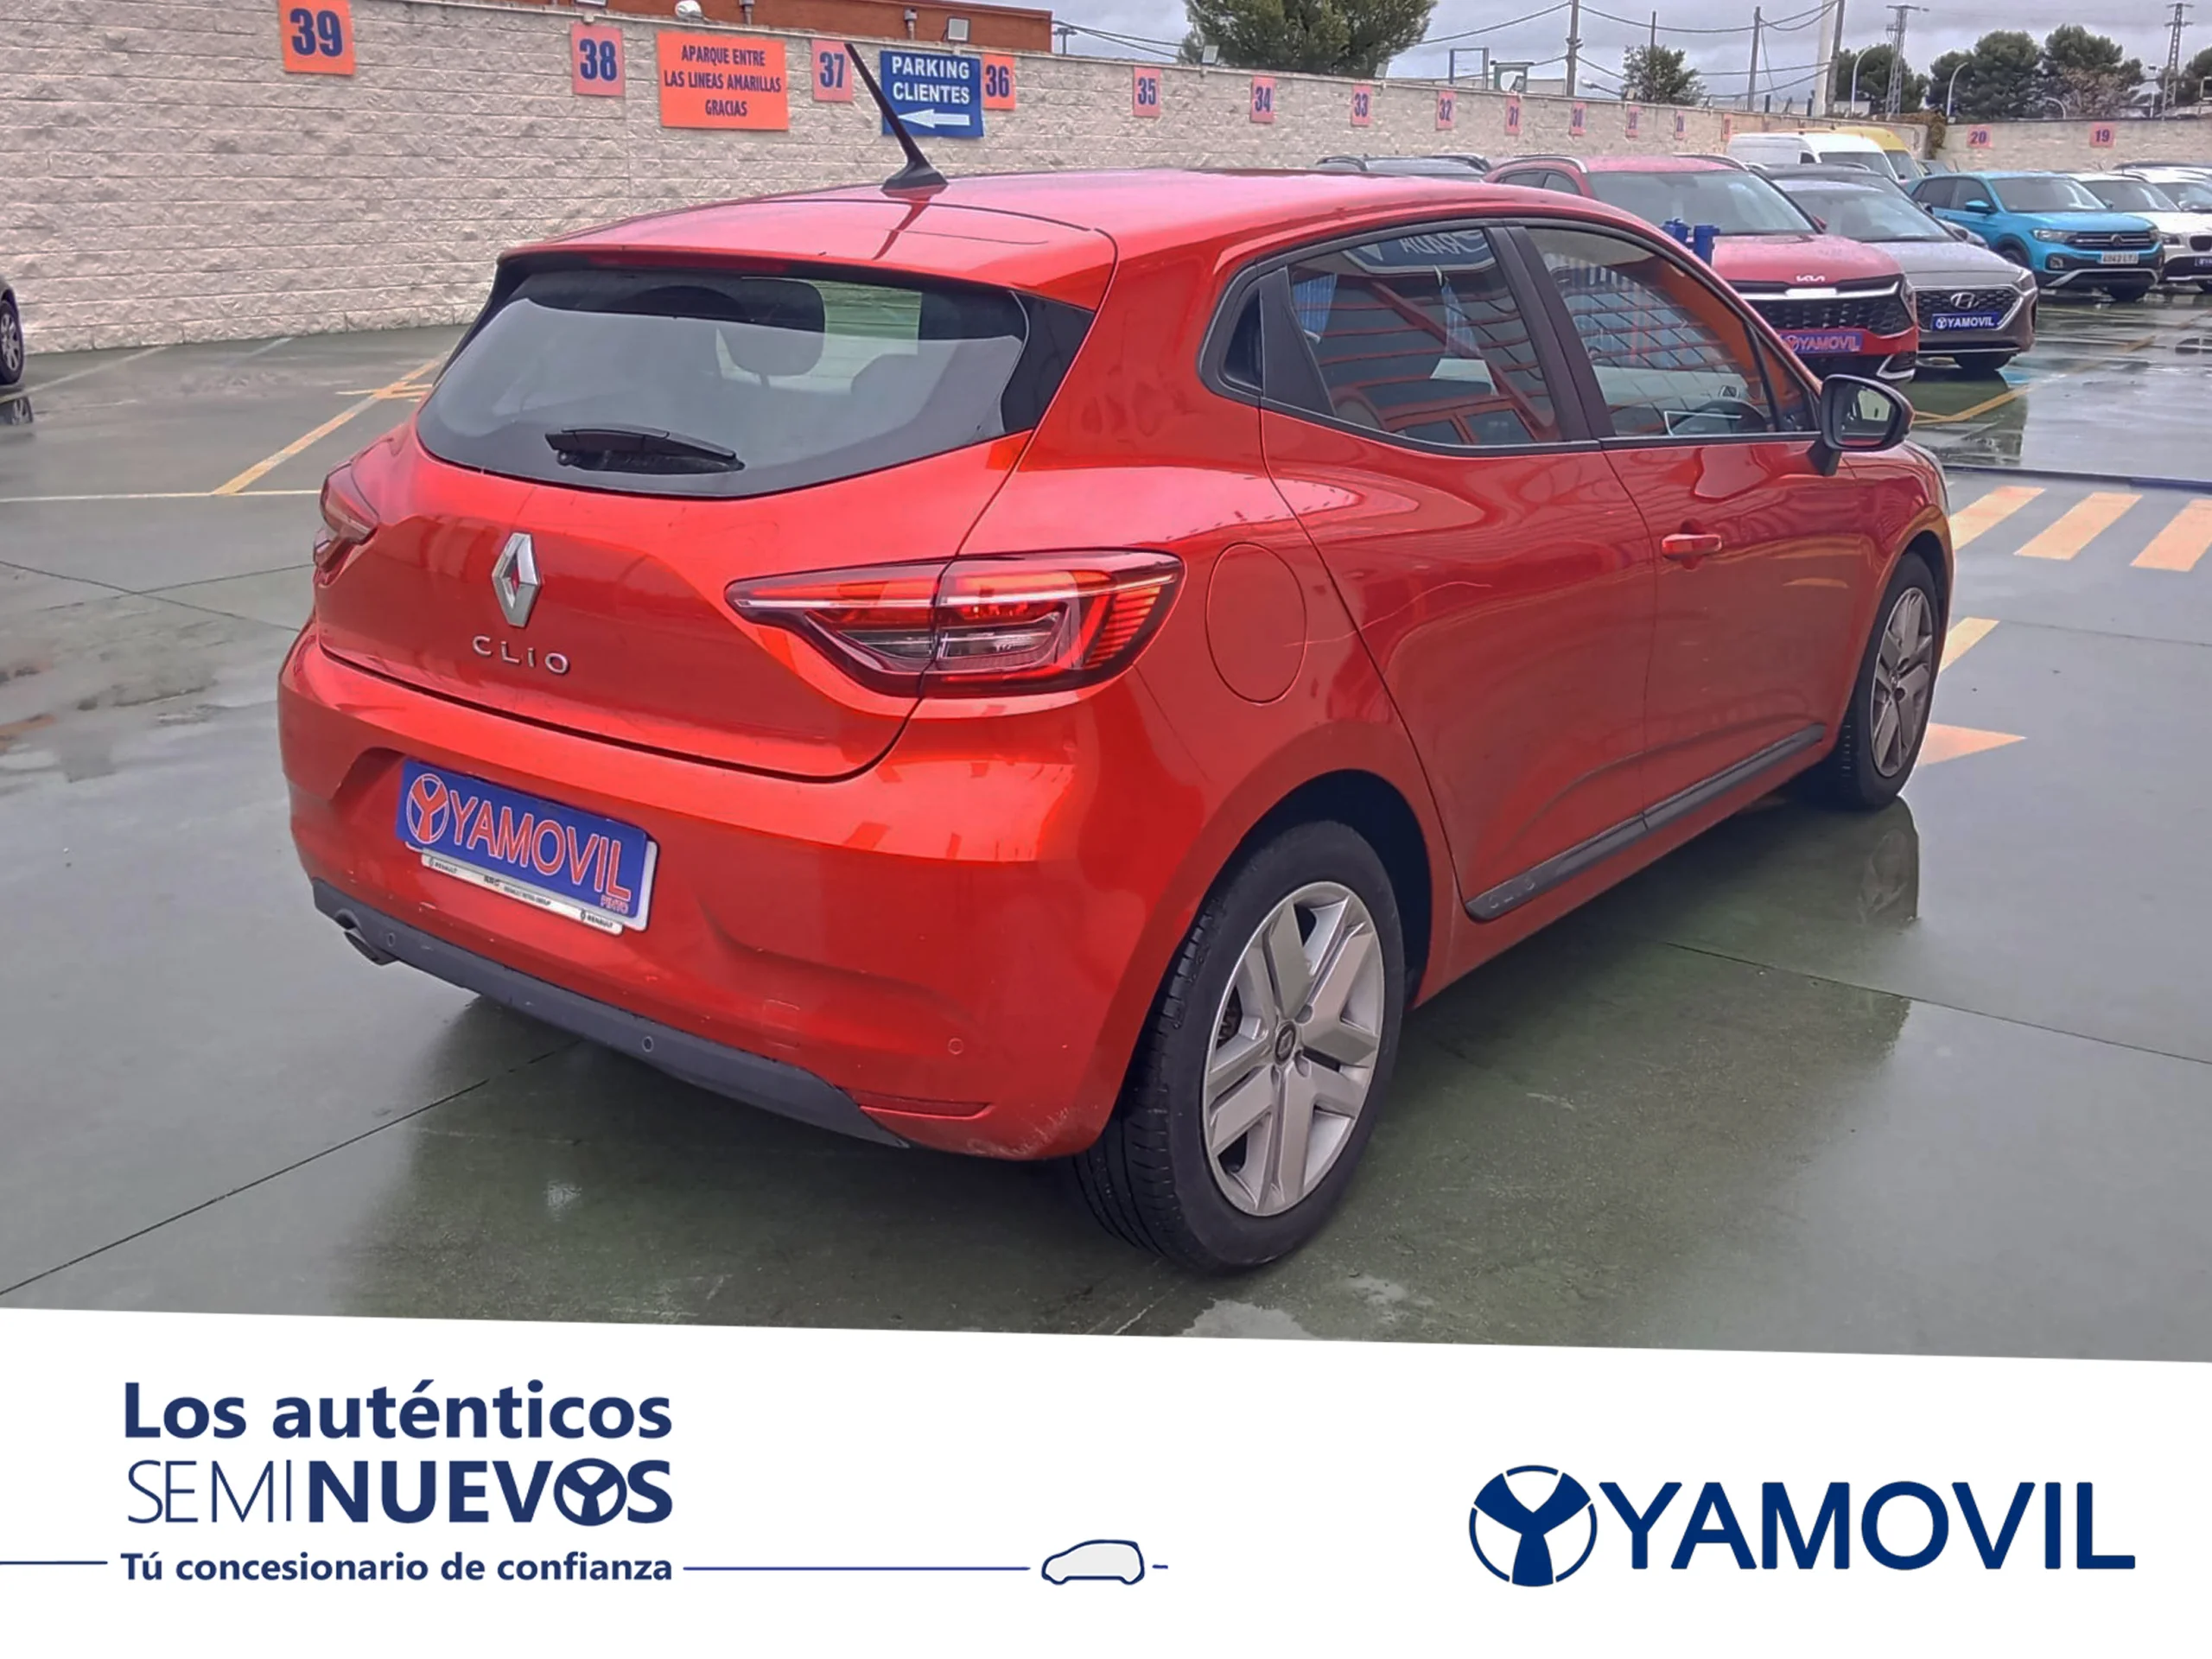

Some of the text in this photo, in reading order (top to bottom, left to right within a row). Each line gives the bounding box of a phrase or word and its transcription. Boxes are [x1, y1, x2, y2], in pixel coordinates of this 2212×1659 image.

[289, 9, 344, 57] 39
[579, 39, 618, 82] 38
[682, 45, 766, 67] APARQUE ENTRE
[892, 55, 969, 79] PARKING
[664, 70, 781, 93] LAS LINEAS AMARILLAS
[819, 52, 845, 88] 37
[985, 65, 1009, 98] 36
[893, 82, 969, 105] CLIENTES
[1137, 77, 1156, 105] 35
[1255, 86, 1271, 112] 34
[705, 99, 748, 117] GRACIAS
[1354, 92, 1369, 118] 33
[1439, 99, 1452, 123] 32
[1970, 130, 1988, 144] 20
[2094, 128, 2111, 143] 19
[1948, 316, 1995, 328] YAMOVIL
[1799, 335, 1860, 353] YAMOVIL
[473, 634, 570, 675] CLIO
[449, 790, 631, 903] YAMOVIL
